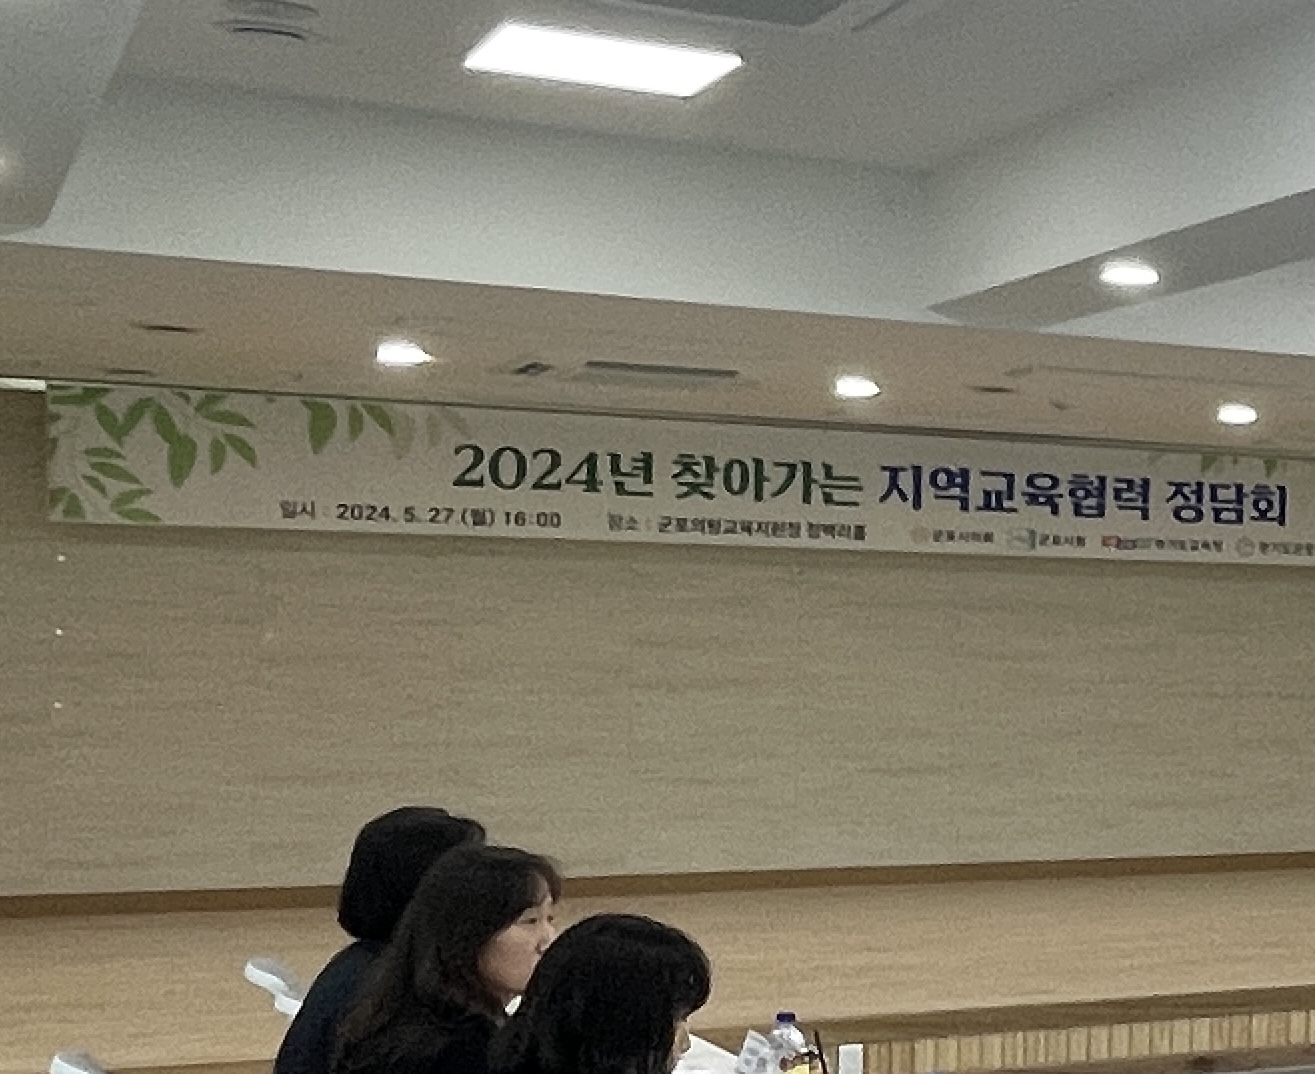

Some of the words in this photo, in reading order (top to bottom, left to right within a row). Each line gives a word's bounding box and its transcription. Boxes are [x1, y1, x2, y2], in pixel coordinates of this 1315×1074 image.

[452, 444, 655, 497] 2024년
[670, 453, 864, 507] 찾아가는
[878, 464, 1152, 521] 지역교육협력
[1165, 480, 1289, 527] 정담회
[503, 511, 562, 528] 16:00
